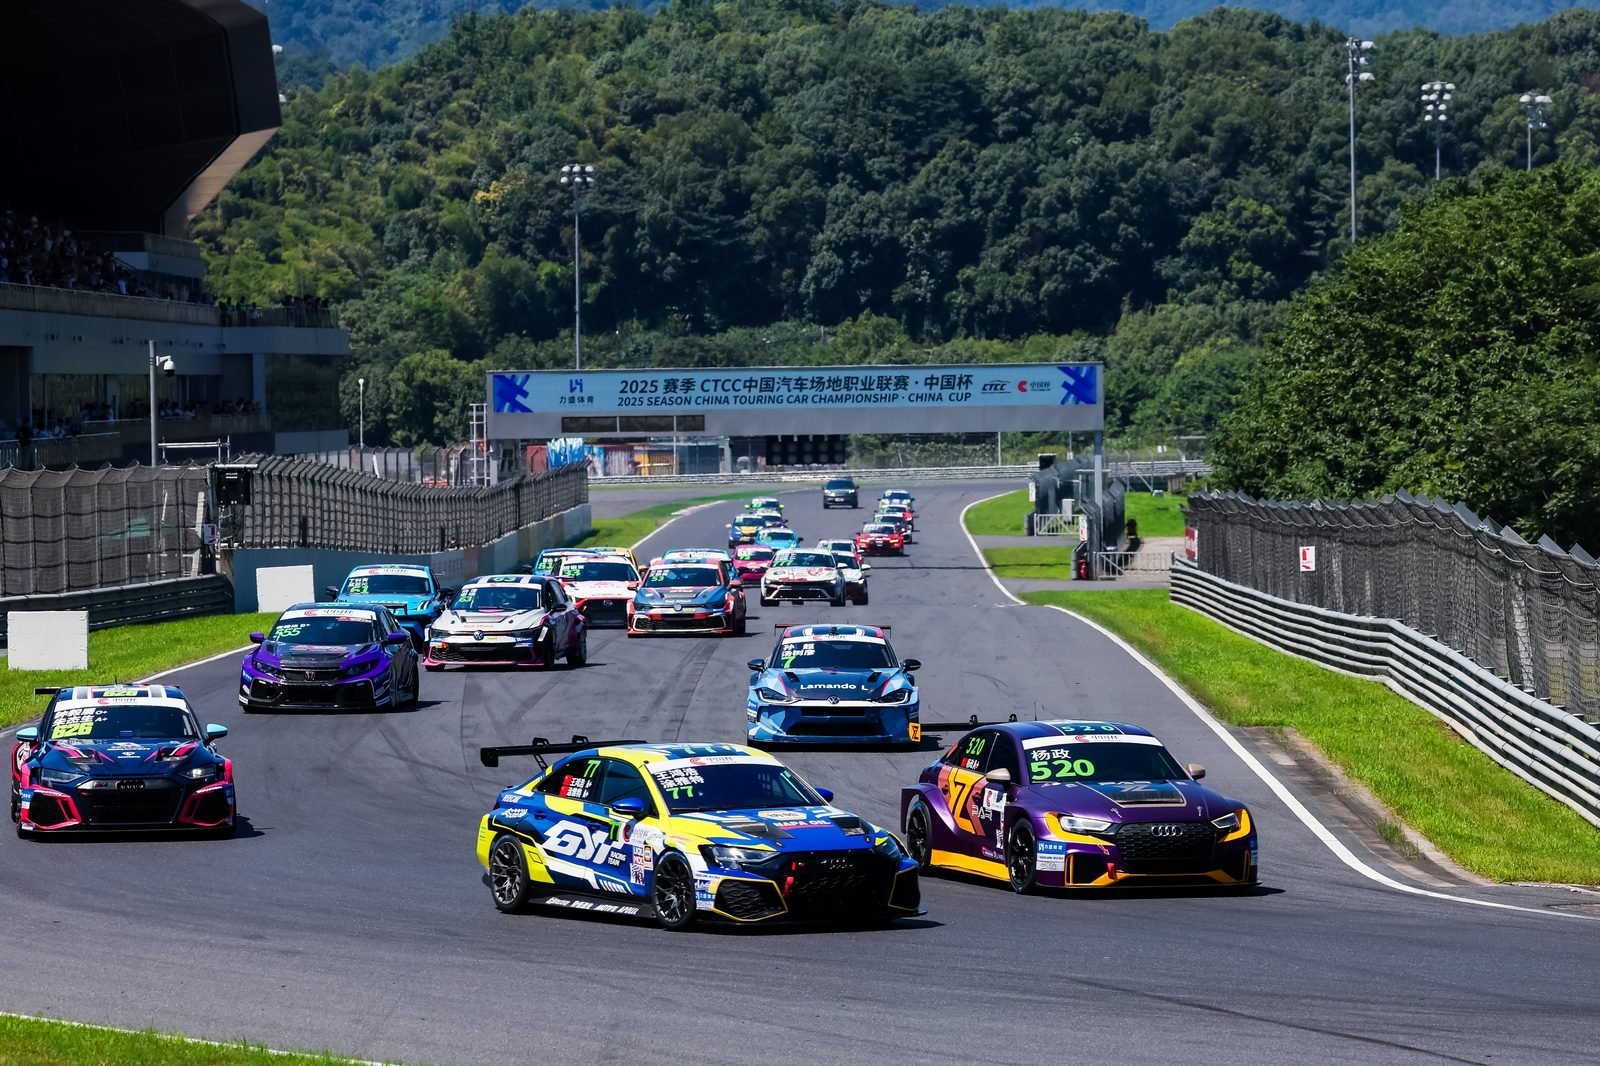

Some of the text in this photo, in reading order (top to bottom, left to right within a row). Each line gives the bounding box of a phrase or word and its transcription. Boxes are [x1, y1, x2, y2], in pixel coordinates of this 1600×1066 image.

[619, 379, 658, 394] 2025
[662, 377, 696, 395] 赛季
[617, 392, 972, 407] 2025 SEASON CHINA TOURING CAR CHAMPIONSHIP CHINA CUP
[459, 595, 473, 603] 63
[275, 627, 302, 637] 555
[781, 655, 797, 669] 7
[51, 721, 94, 739] 626
[966, 737, 986, 756] 520
[1031, 748, 1072, 761] 杨政
[583, 759, 602, 778] 77
[1030, 759, 1095, 781] 520
[665, 785, 694, 800] 77
[772, 819, 808, 827] NAPA
[607, 857, 620, 867] TEAM
[610, 850, 627, 862] RACING
